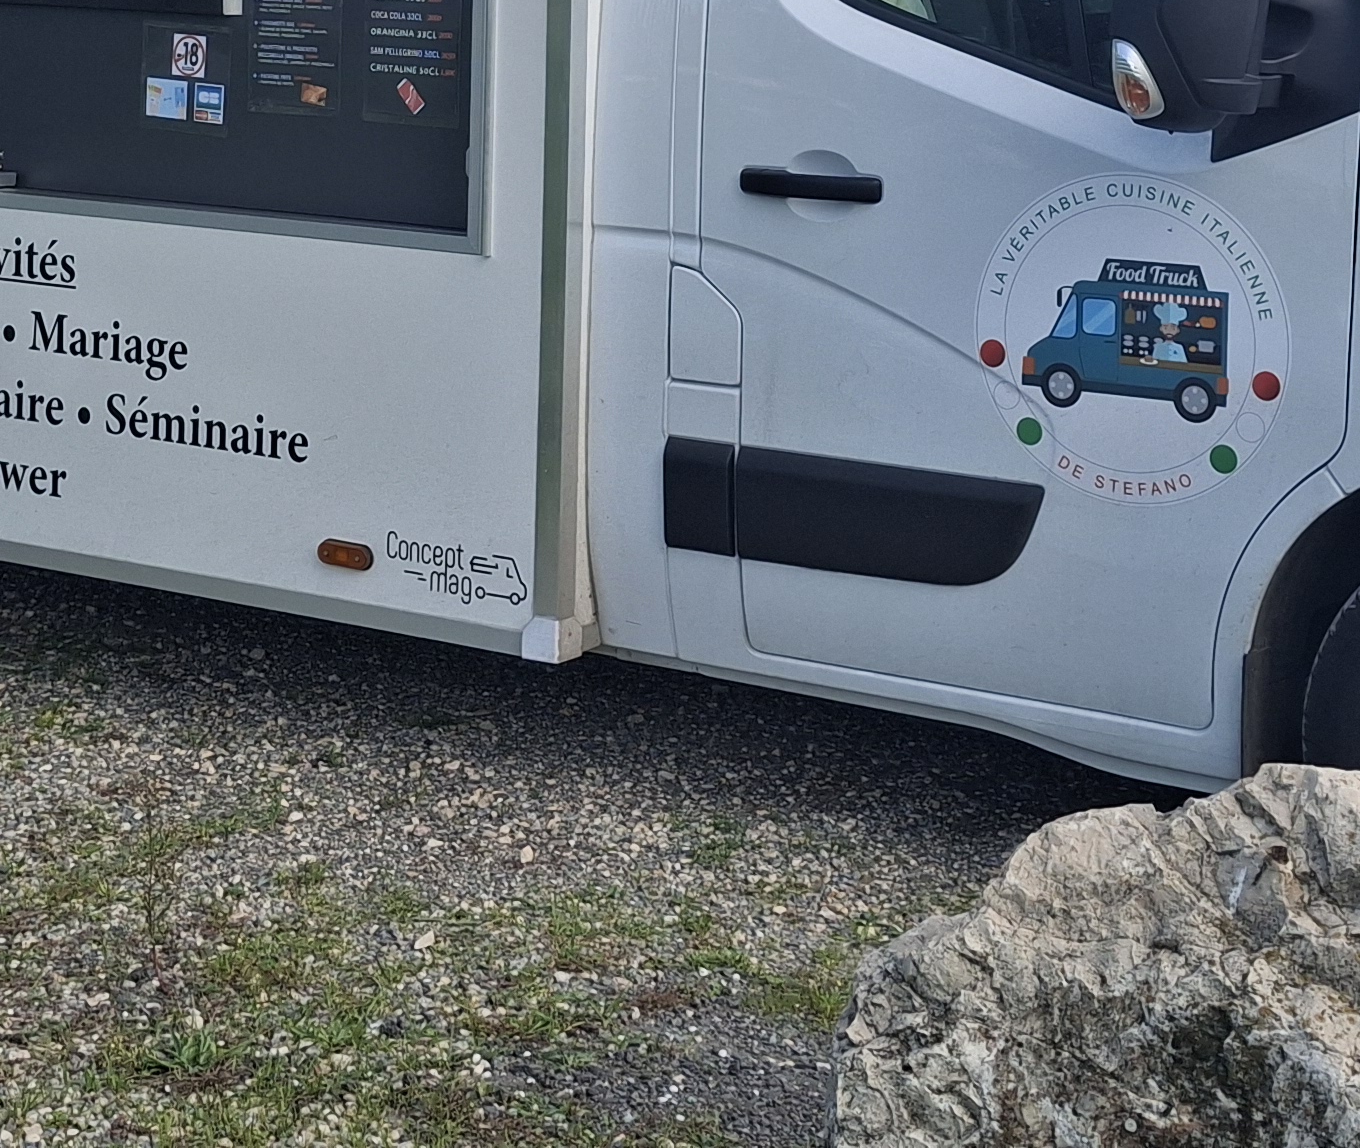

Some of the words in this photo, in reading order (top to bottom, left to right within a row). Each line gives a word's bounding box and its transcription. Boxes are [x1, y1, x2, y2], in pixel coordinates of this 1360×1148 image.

[370, 10, 388, 19] COCA
[389, 11, 406, 20] COLA
[370, 27, 414, 37] ORANGINA
[990, 270, 1008, 296] LA
[1003, 186, 1096, 263] VÉRITABLE
[1106, 183, 1196, 217] CUISINE
[1200, 212, 1273, 322] ITALIENNE
[1106, 261, 1147, 283] Food
[1150, 265, 1199, 288] Truck
[29, 310, 189, 381] Mariage
[104, 393, 310, 464] Séminaire
[1057, 454, 1085, 480] DE
[1094, 472, 1193, 497] STEFANO
[386, 530, 464, 571] Concept
[430, 570, 472, 605] mag
